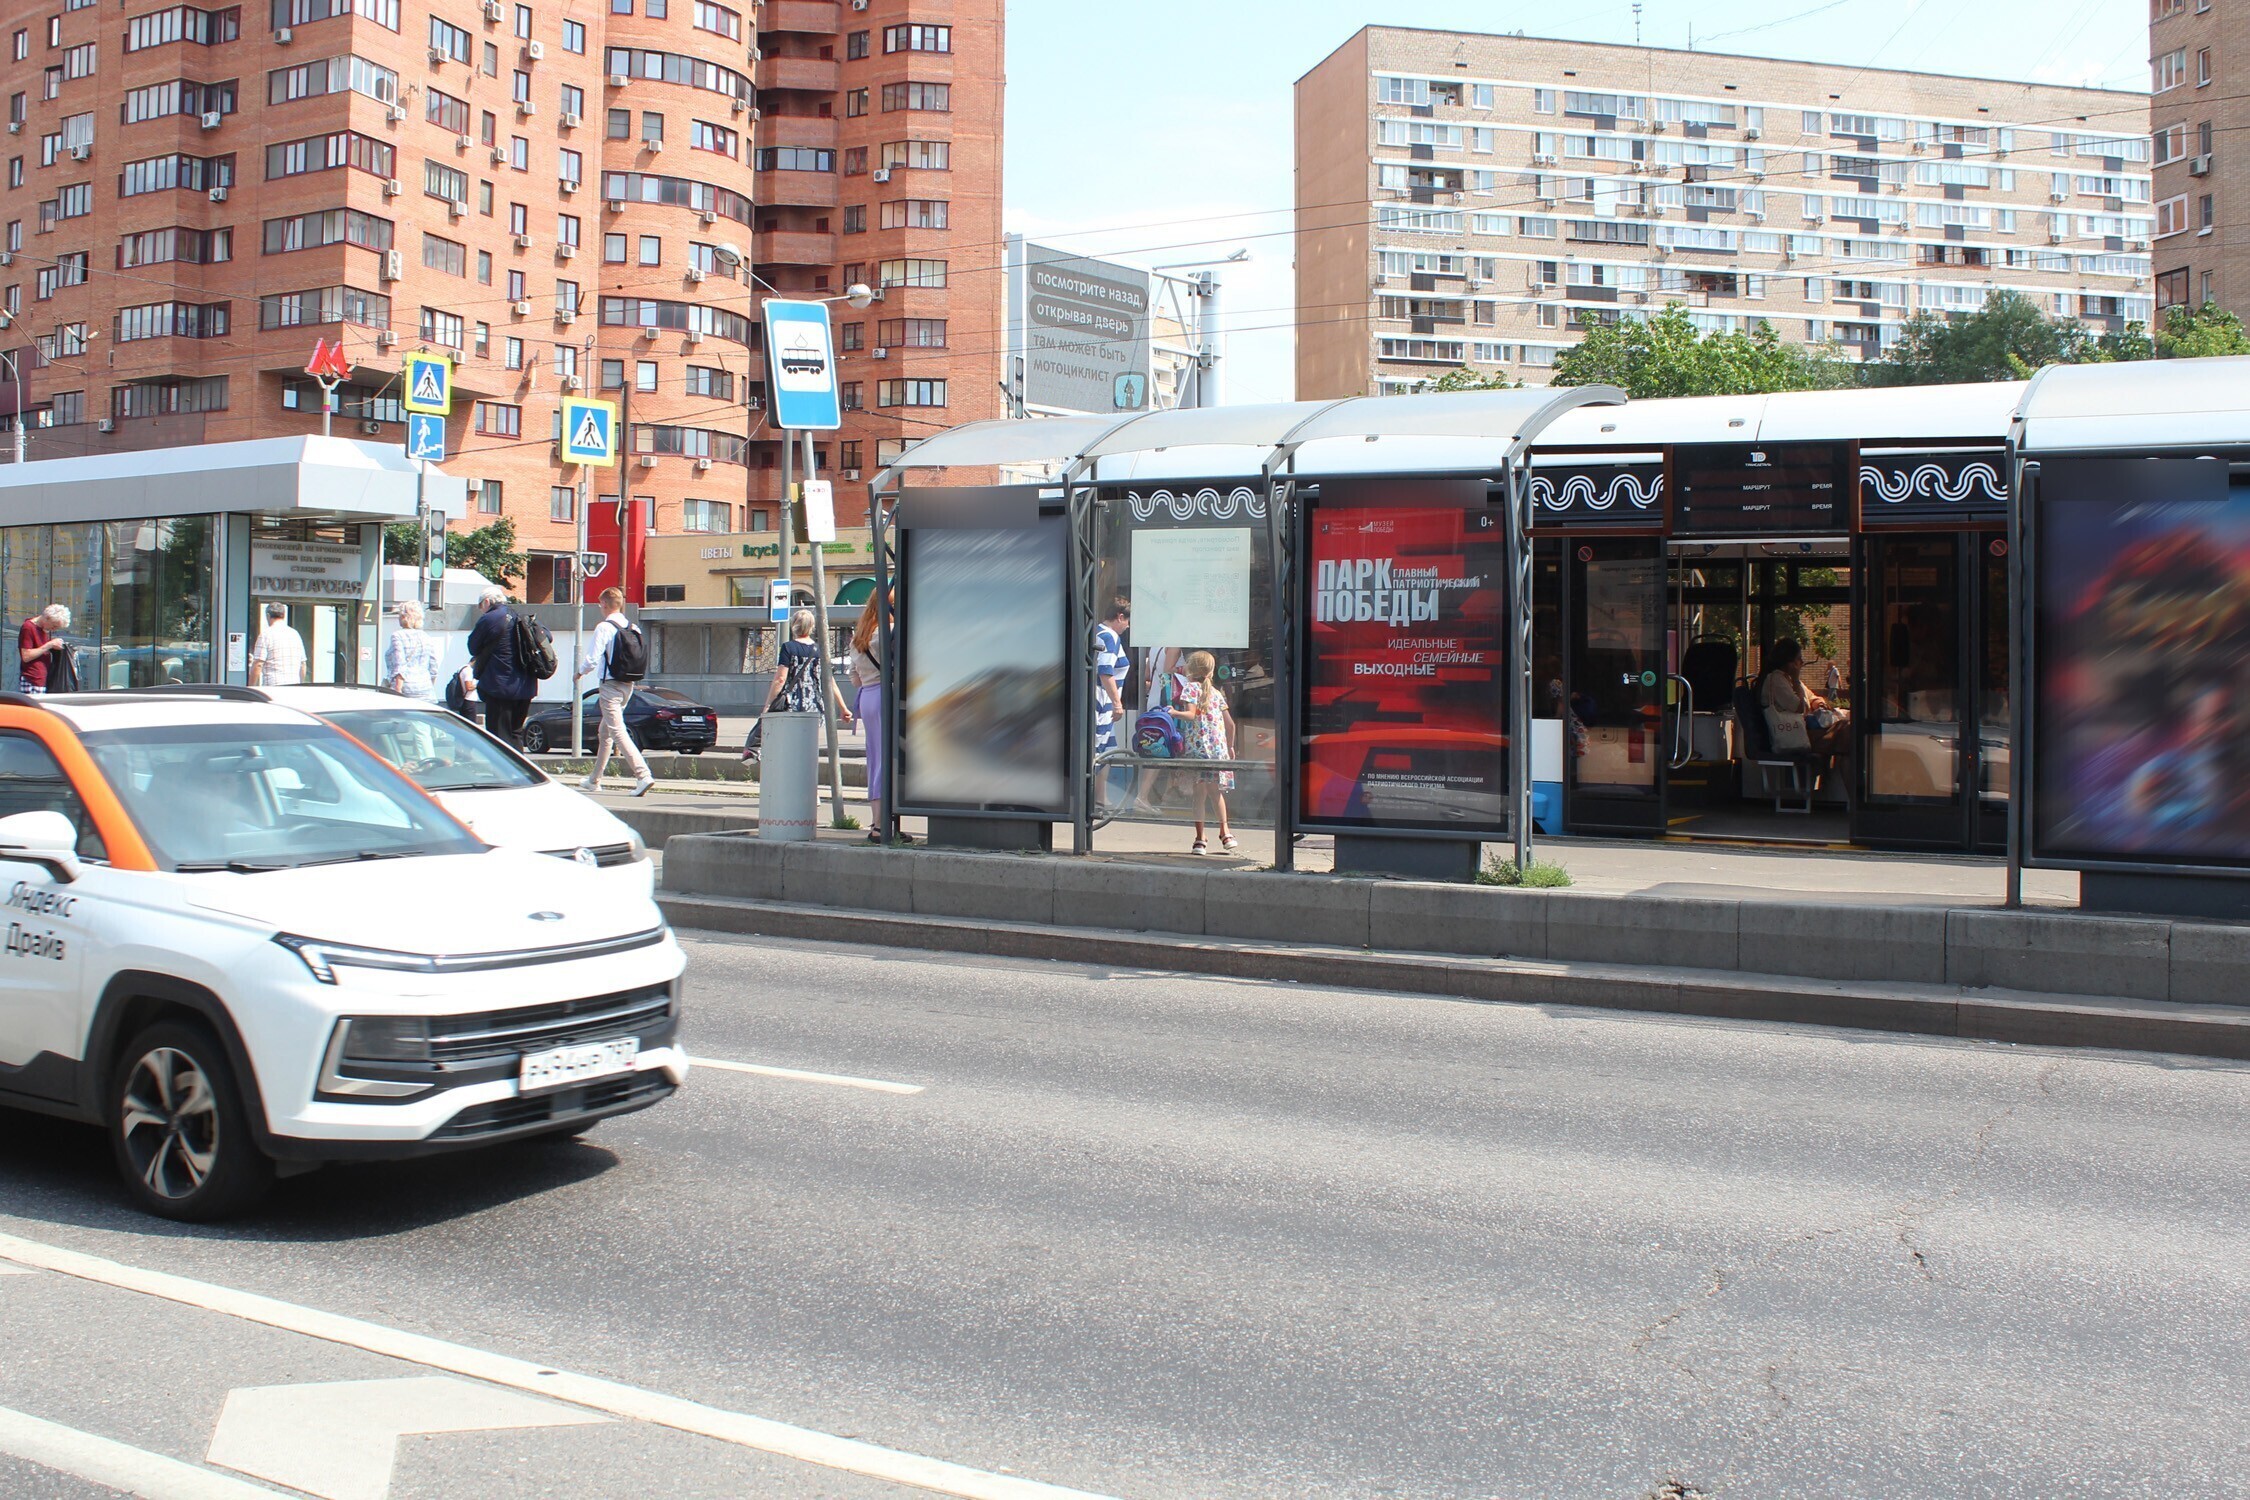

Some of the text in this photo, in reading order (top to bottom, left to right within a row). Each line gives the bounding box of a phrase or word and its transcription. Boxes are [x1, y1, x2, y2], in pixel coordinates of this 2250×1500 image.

[1037, 272, 1143, 309] посмотрите назад,
[1036, 304, 1129, 334] открывая дверь
[1033, 335, 1126, 363] там может быть
[1033, 358, 1110, 383] мотоциклист
[1480, 516, 1494, 527] 0+
[701, 547, 733, 560] ЦВЕТЫ
[1318, 558, 1392, 590] ПАРК
[1393, 565, 1438, 578] ГЛАВНЫЙ
[1392, 576, 1480, 590] ПАТРИОТИЧЕСКИЙ
[363, 603, 373, 618] 7
[1317, 589, 1439, 627] ПОБЕДЫ
[1388, 638, 1458, 650] ИДЕАЛЬНЫЕ
[1413, 651, 1484, 663] СЕМЕЙНЫЕ
[1354, 663, 1436, 677] ВЫХОДНЫЕ
[1376, 773, 1400, 781] МНЕНИЮ
[1400, 774, 1446, 782] ВСЕРОССИЙСКОЙ
[4, 880, 79, 918] Яндекс
[5, 922, 66, 960] Драйв
